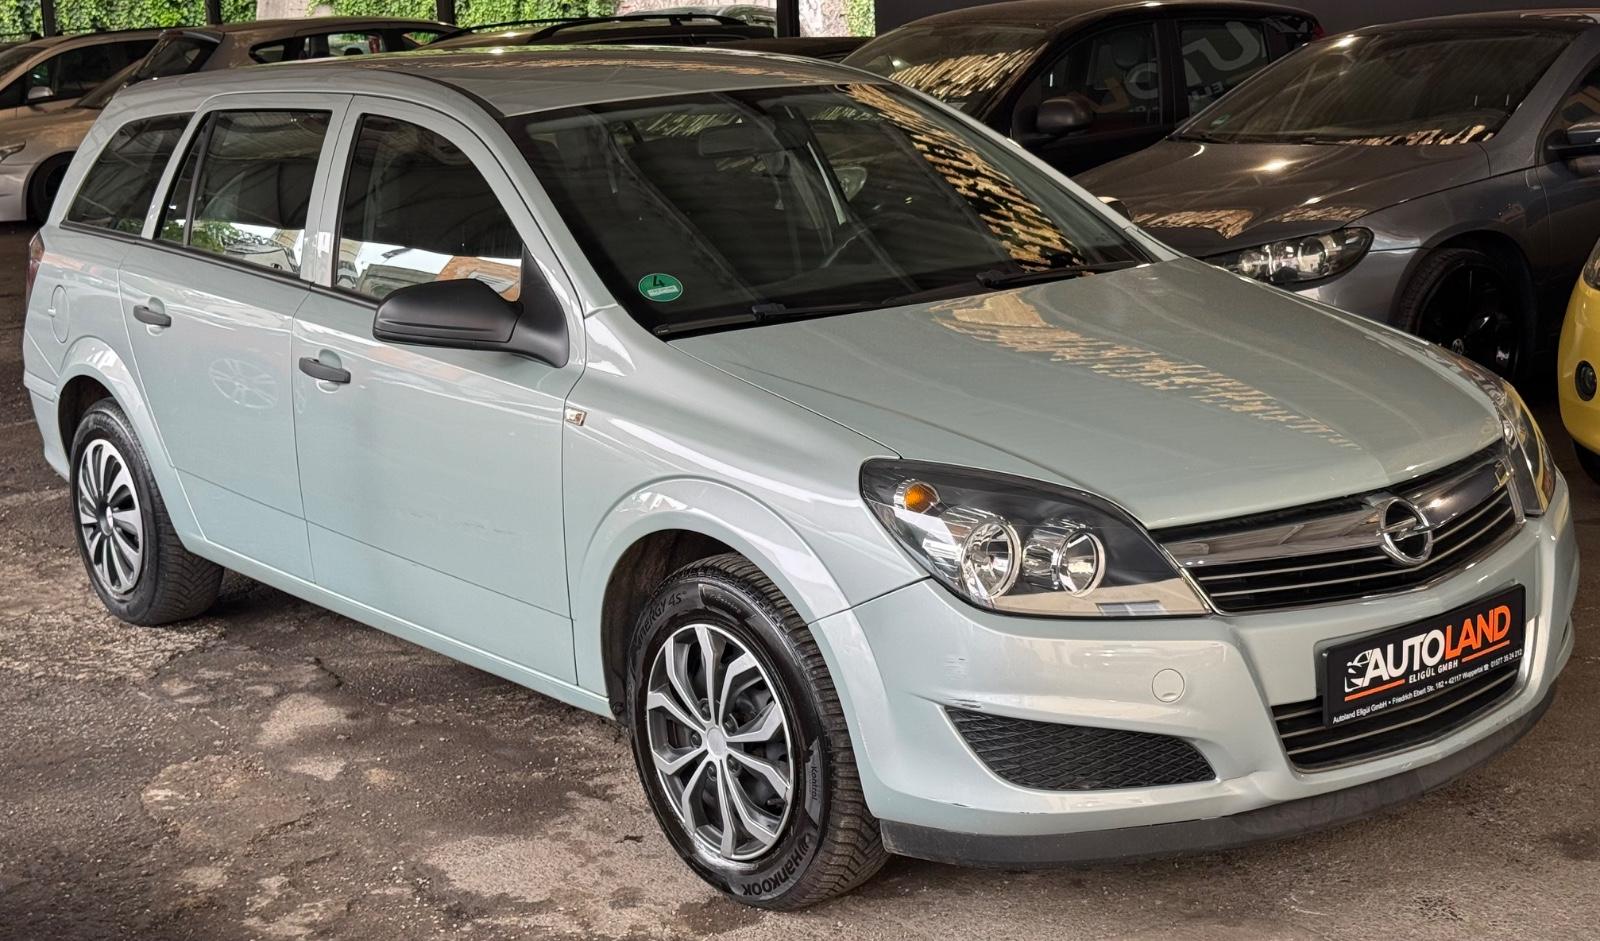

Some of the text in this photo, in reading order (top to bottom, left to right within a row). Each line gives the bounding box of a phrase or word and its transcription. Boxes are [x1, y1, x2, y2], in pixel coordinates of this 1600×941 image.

[1363, 605, 1511, 687] AUTOLAND
[1408, 659, 1459, 684] ELIGÜL GMBH
[1333, 710, 1356, 724] Autoland
[1371, 701, 1388, 712] GmbH
[1392, 692, 1413, 705] Friedrich
[1413, 687, 1427, 698] Ebert
[1462, 665, 1483, 680] Wuppertal
